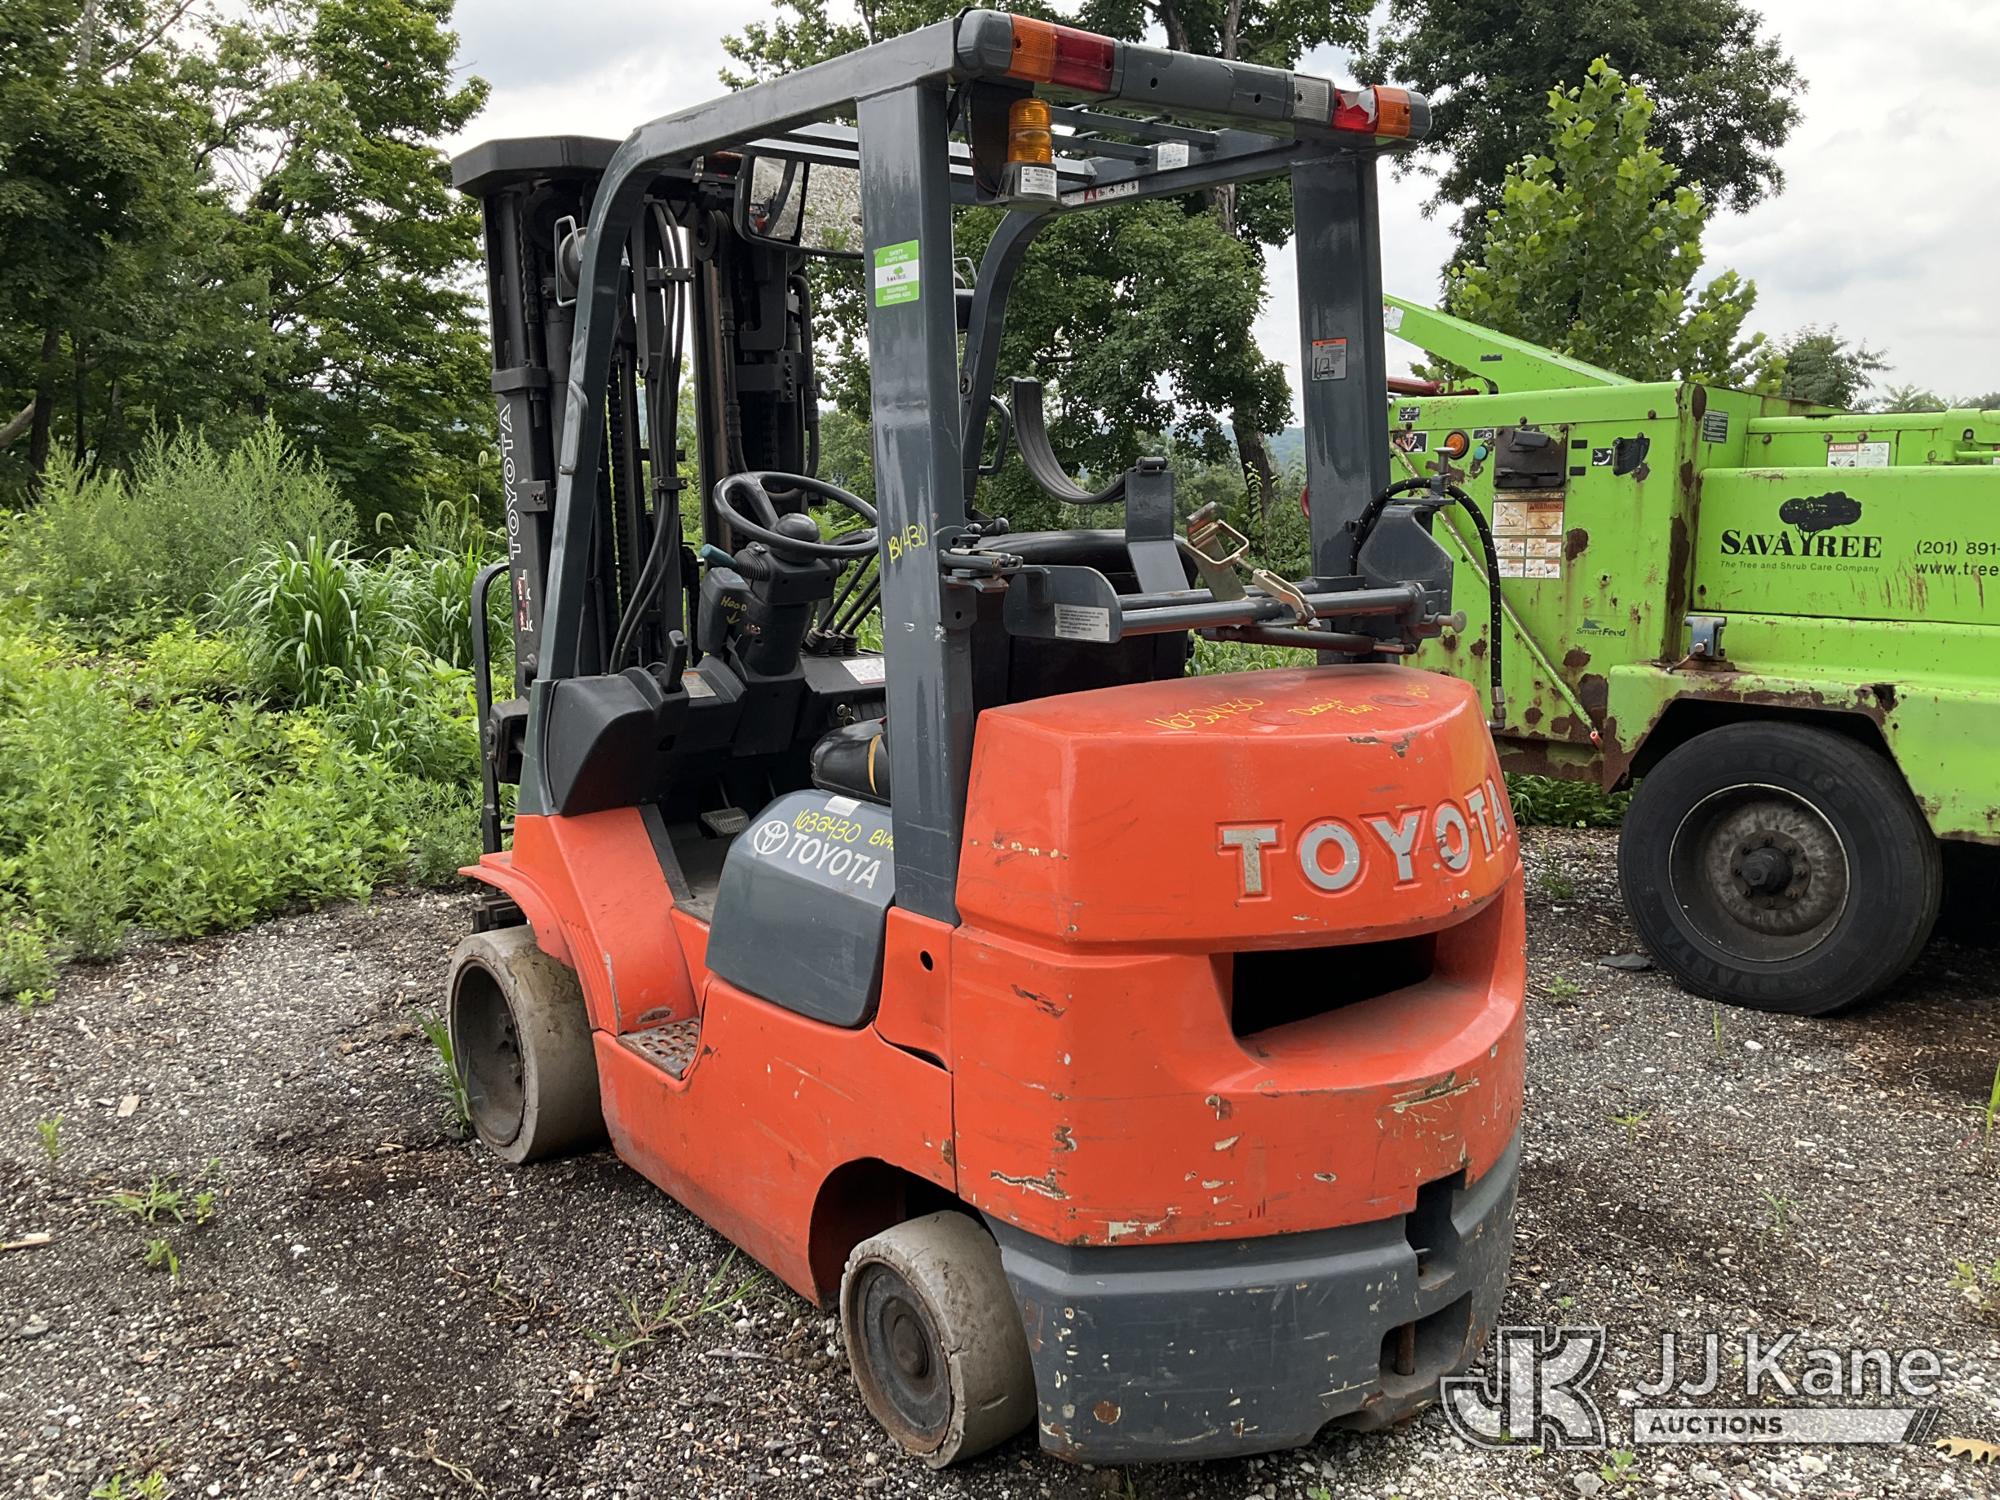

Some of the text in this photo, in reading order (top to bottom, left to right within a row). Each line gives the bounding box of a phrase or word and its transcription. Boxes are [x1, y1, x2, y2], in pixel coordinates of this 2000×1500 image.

[499, 402, 522, 561] TOYOTA
[1720, 560, 1737, 568] The
[1739, 560, 1758, 569] Tree
[1780, 562, 1807, 570] Shrub
[1810, 562, 1833, 571] Care
[1835, 563, 1880, 574] Company
[1916, 539, 1958, 556] (201)
[786, 832, 881, 889] TOYOTA
[1216, 778, 1512, 899] TOYOTA
